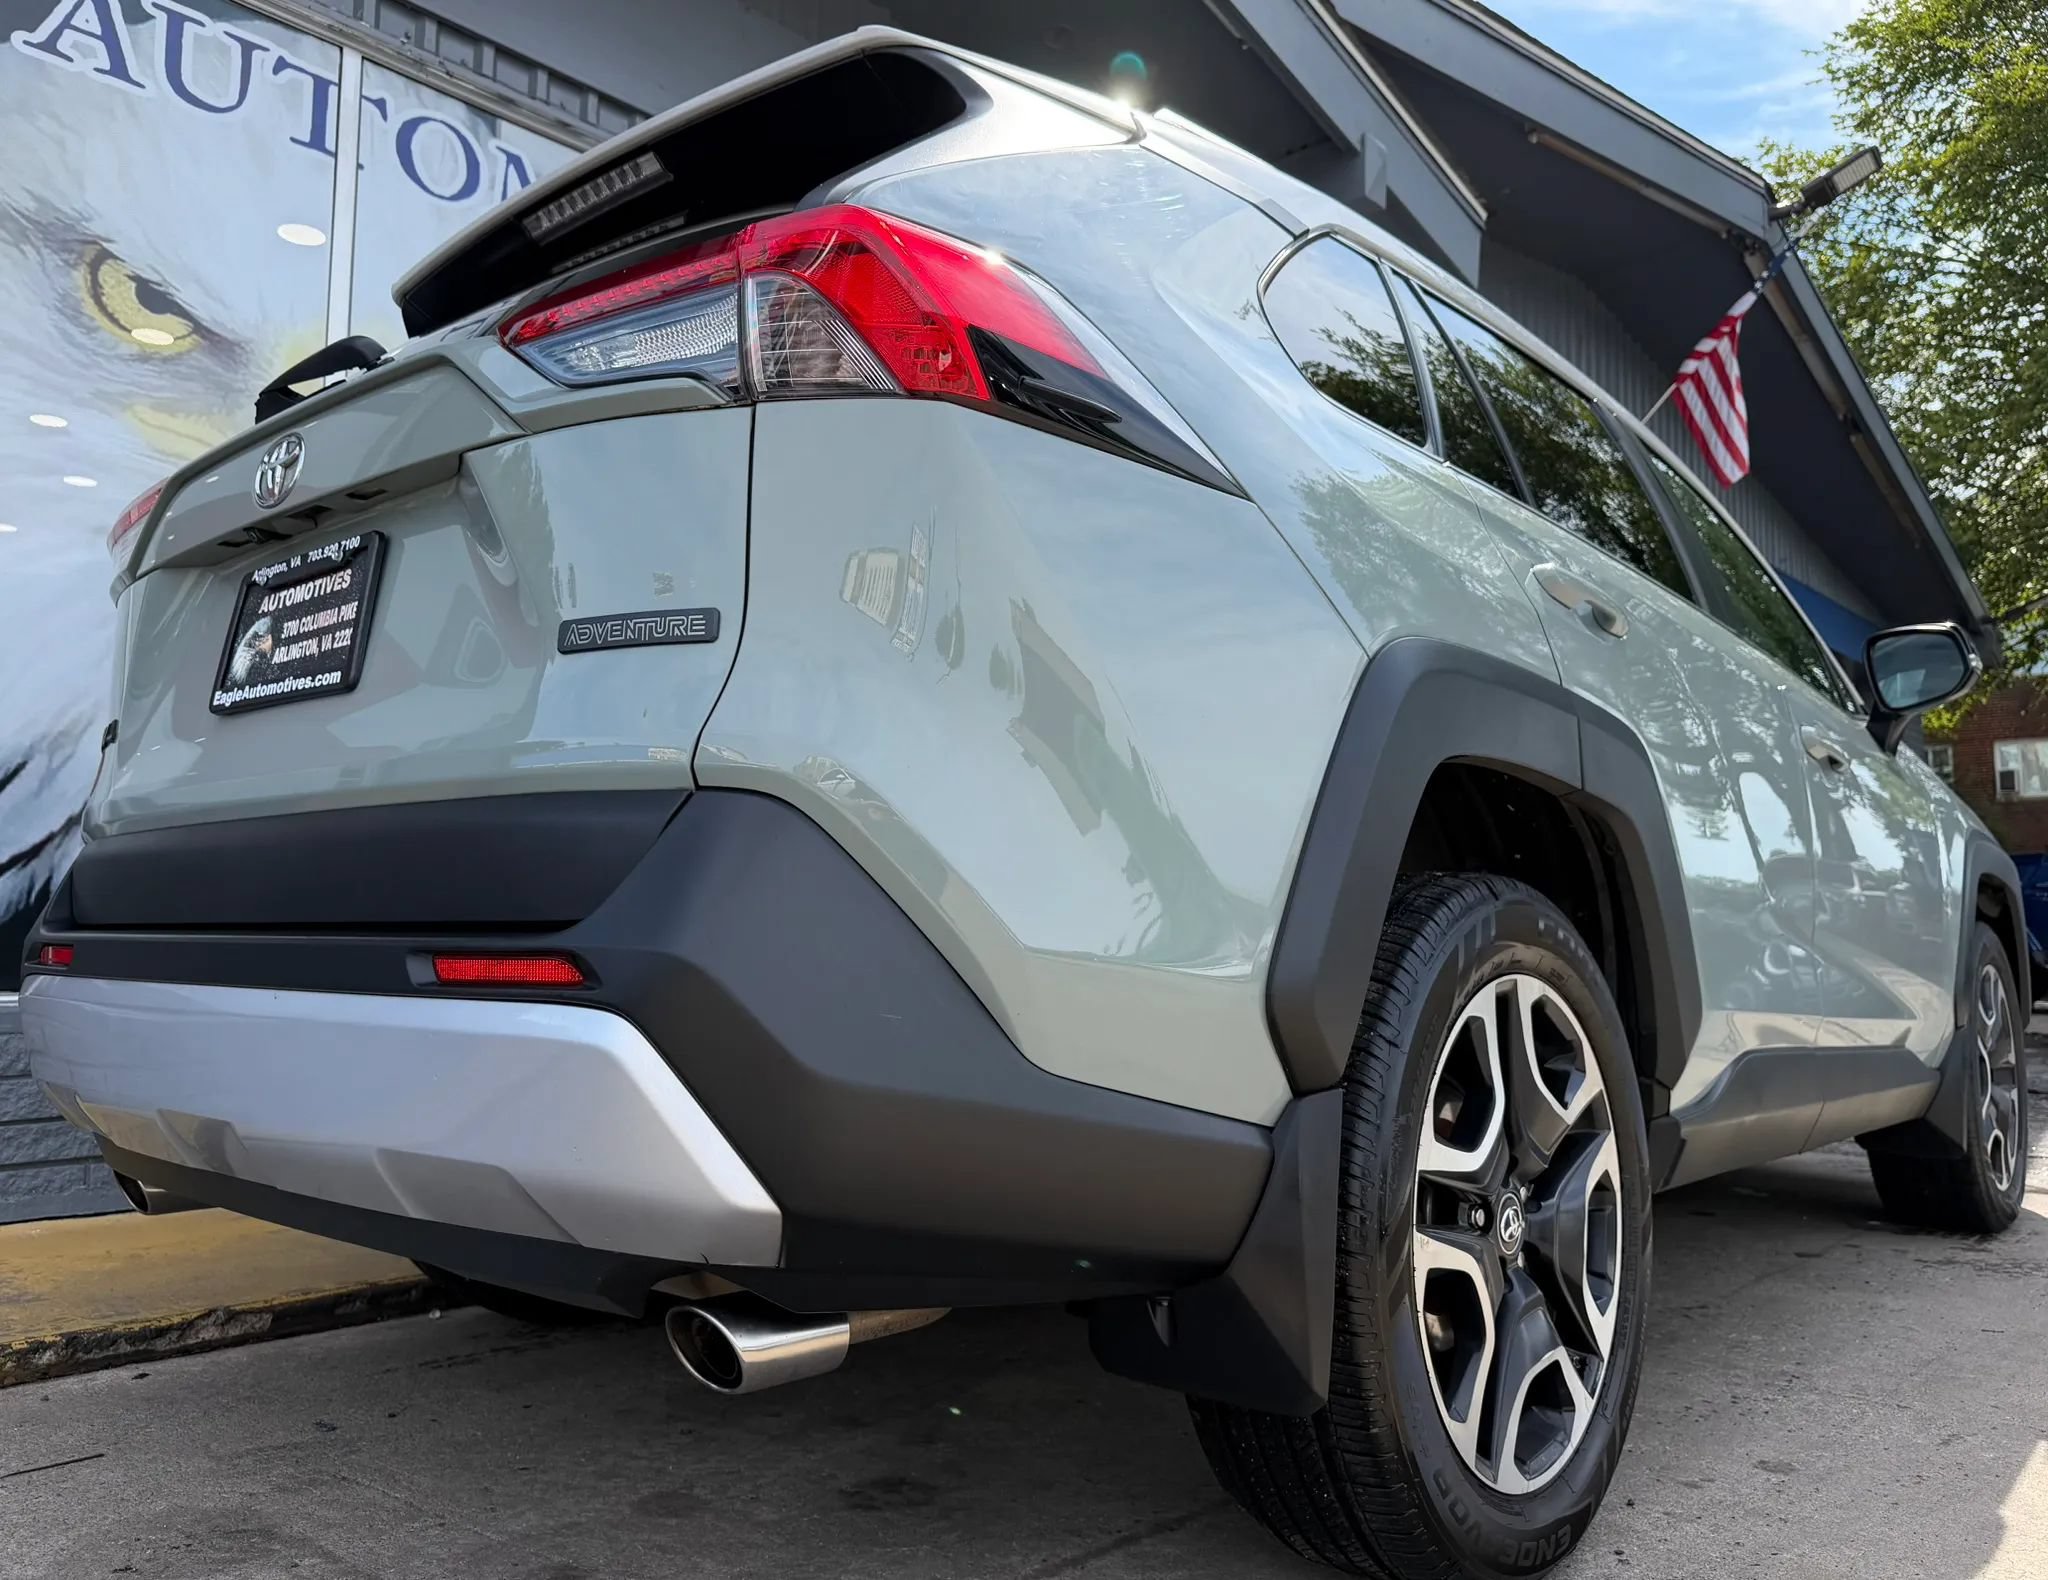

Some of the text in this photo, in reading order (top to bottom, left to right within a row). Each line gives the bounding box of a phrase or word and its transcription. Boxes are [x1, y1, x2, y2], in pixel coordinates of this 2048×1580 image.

[290, 555, 302, 569] VA
[307, 536, 361, 563] 703.9207100
[258, 569, 353, 614] AUTOMOTIVES
[281, 601, 359, 640] 3700 COLUMBIA PIKE
[563, 615, 707, 647] ADVENTURE
[271, 637, 319, 665] ARLINGTON,
[321, 633, 333, 652] VA
[212, 670, 342, 707] EagleAutomotives.com
